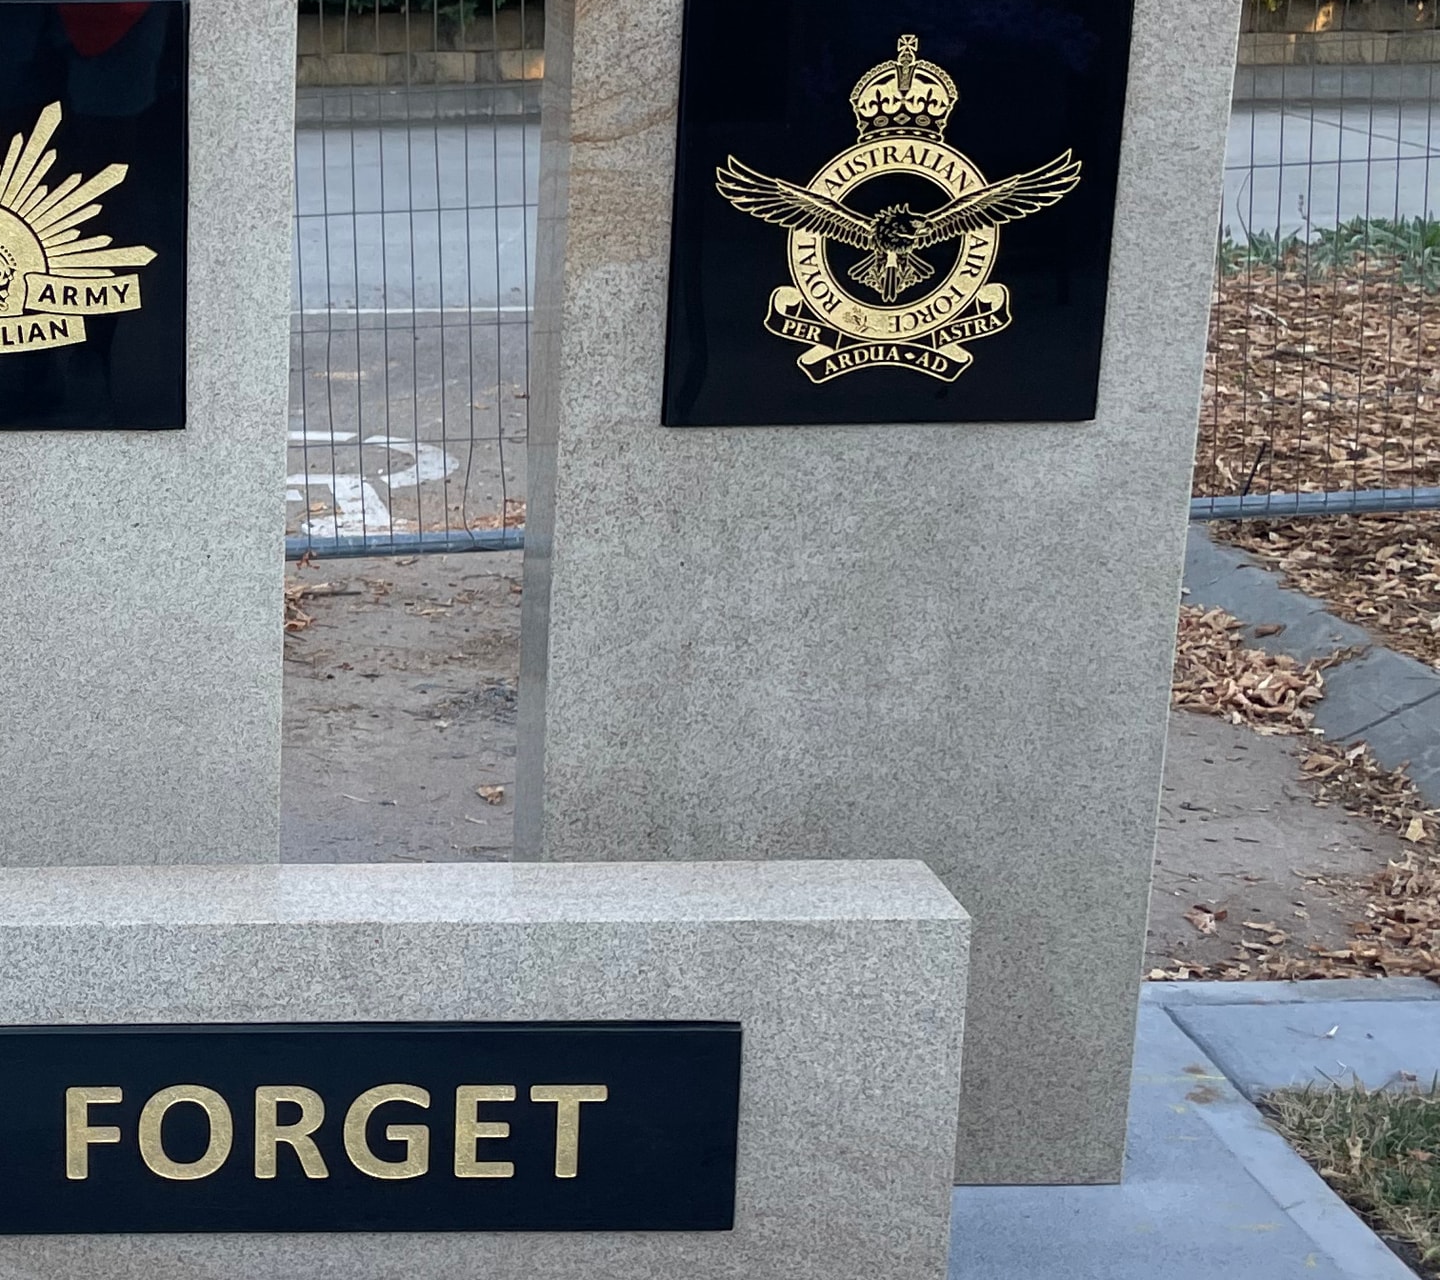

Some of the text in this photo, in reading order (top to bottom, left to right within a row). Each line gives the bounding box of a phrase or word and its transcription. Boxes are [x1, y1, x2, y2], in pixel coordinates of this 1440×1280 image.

[797, 145, 989, 333] ROYAL AUSTRALIAN AIR FORCE
[37, 283, 130, 305] ARMY
[781, 314, 1002, 376] PER ARDUA AD ASTRA
[65, 1083, 608, 1181] FORGET
